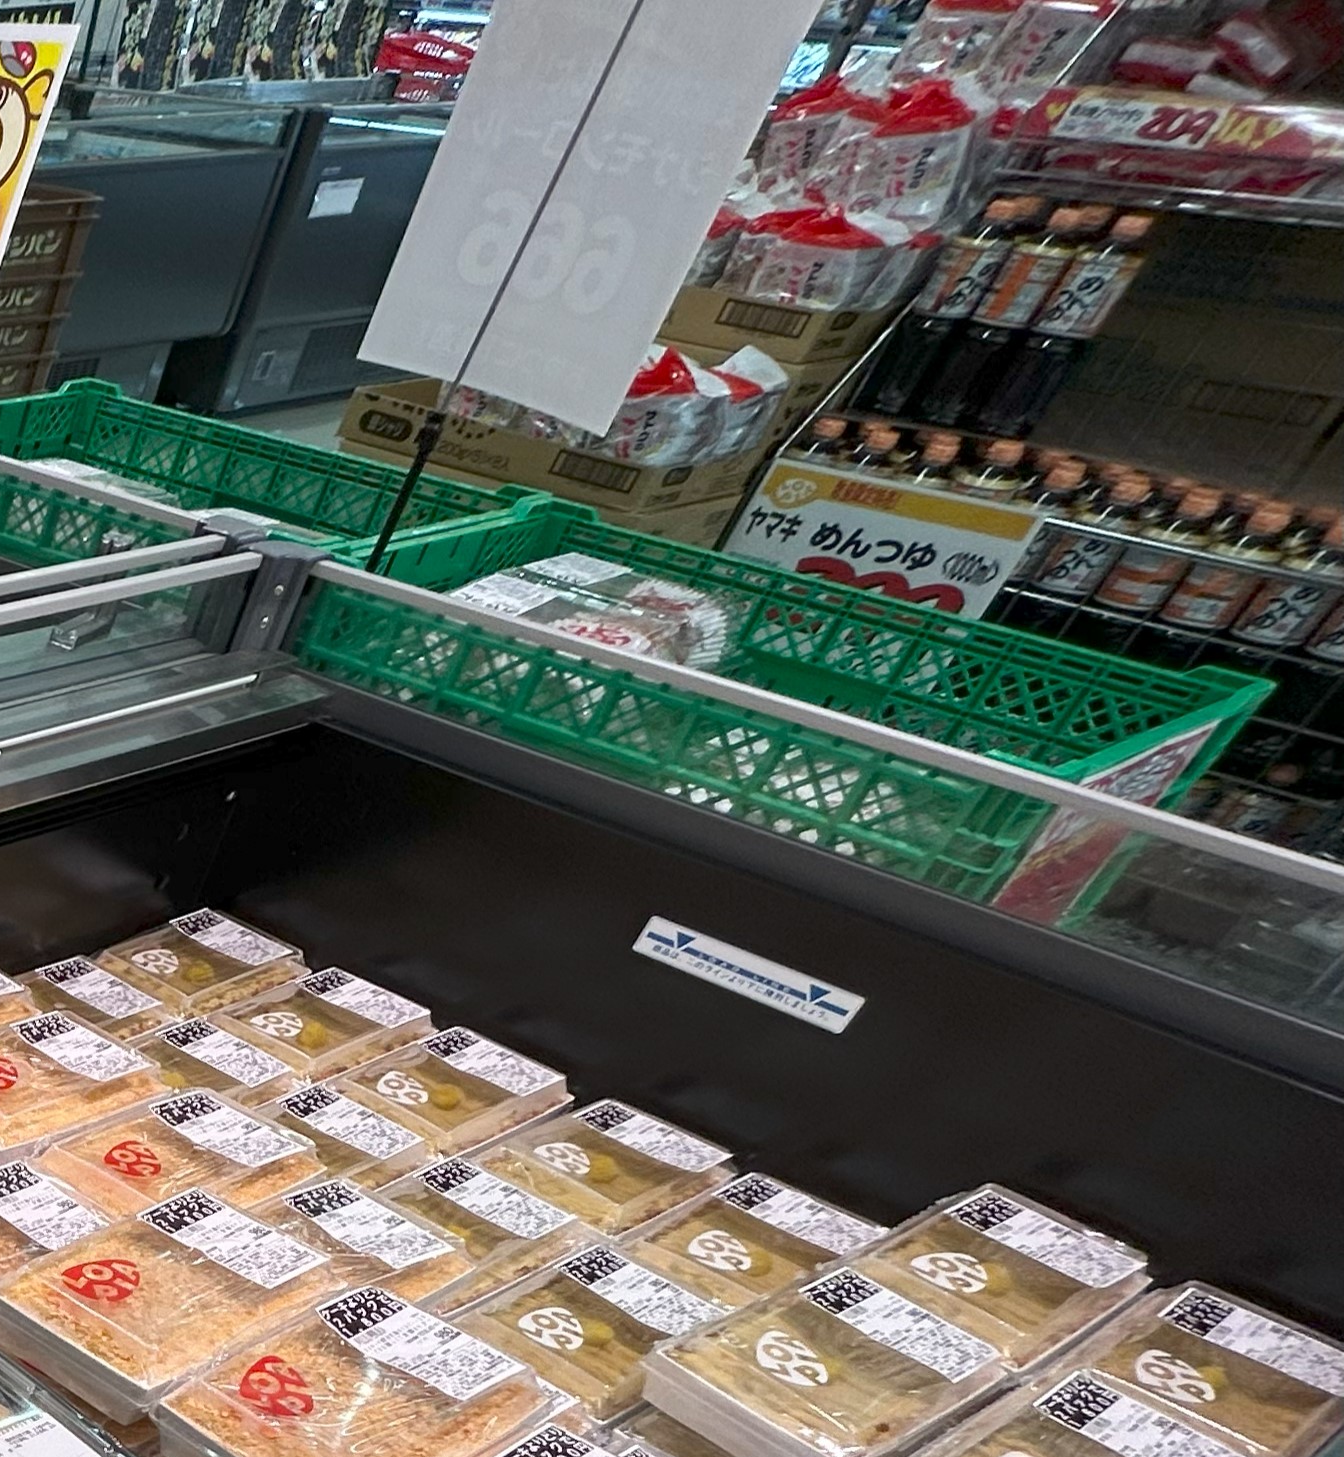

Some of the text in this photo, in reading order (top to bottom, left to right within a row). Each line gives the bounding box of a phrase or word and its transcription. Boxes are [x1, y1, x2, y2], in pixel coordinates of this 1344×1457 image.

[746, 507, 802, 542] ヤマキ
[810, 522, 937, 572] めんつゆ
